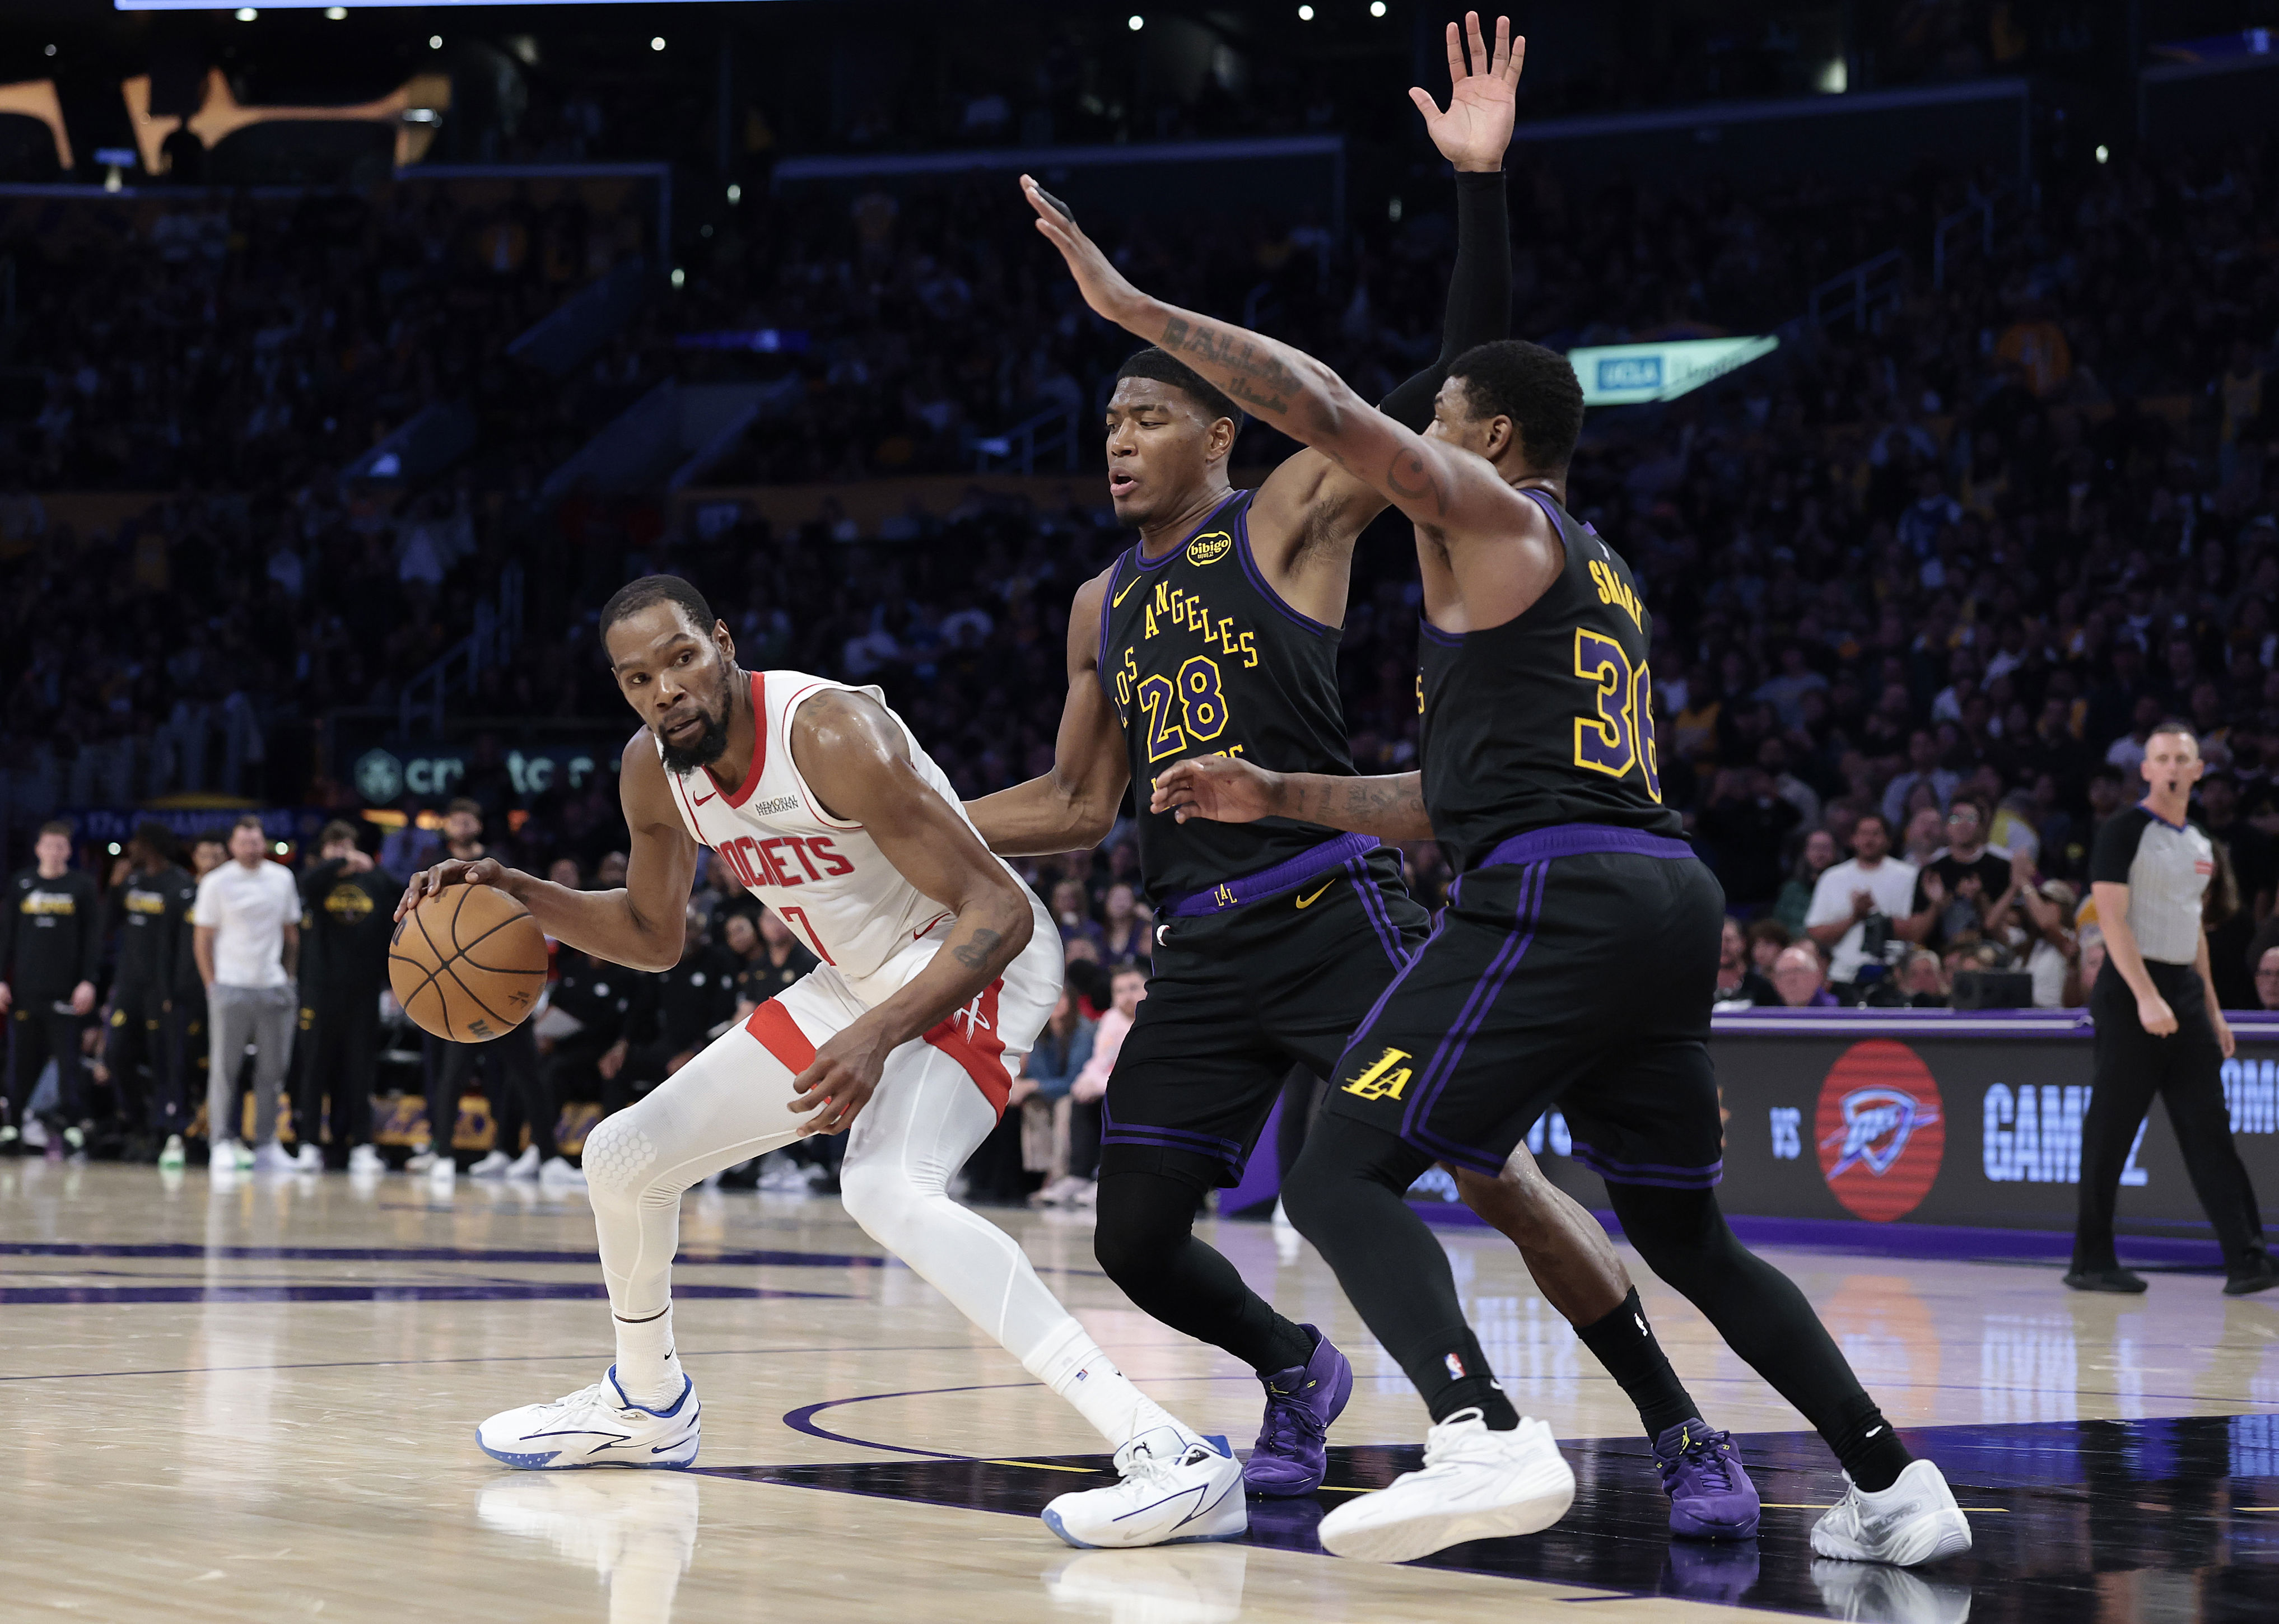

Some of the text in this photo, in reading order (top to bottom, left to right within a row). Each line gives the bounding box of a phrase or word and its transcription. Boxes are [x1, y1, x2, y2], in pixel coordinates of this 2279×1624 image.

[1191, 539, 1229, 556] bibigo
[1145, 580, 1259, 668] ANGELES
[1137, 655, 1229, 764] 28
[755, 795, 798, 810] MEMORIAL
[757, 801, 799, 816] HERMANN
[714, 836, 855, 888] OCKETS
[1214, 883, 1238, 907] LAL
[779, 906, 837, 966] 7
[1341, 1047, 1412, 1101] LA
[1769, 1107, 1801, 1159] VS
[1983, 1082, 2094, 1183] GAM
